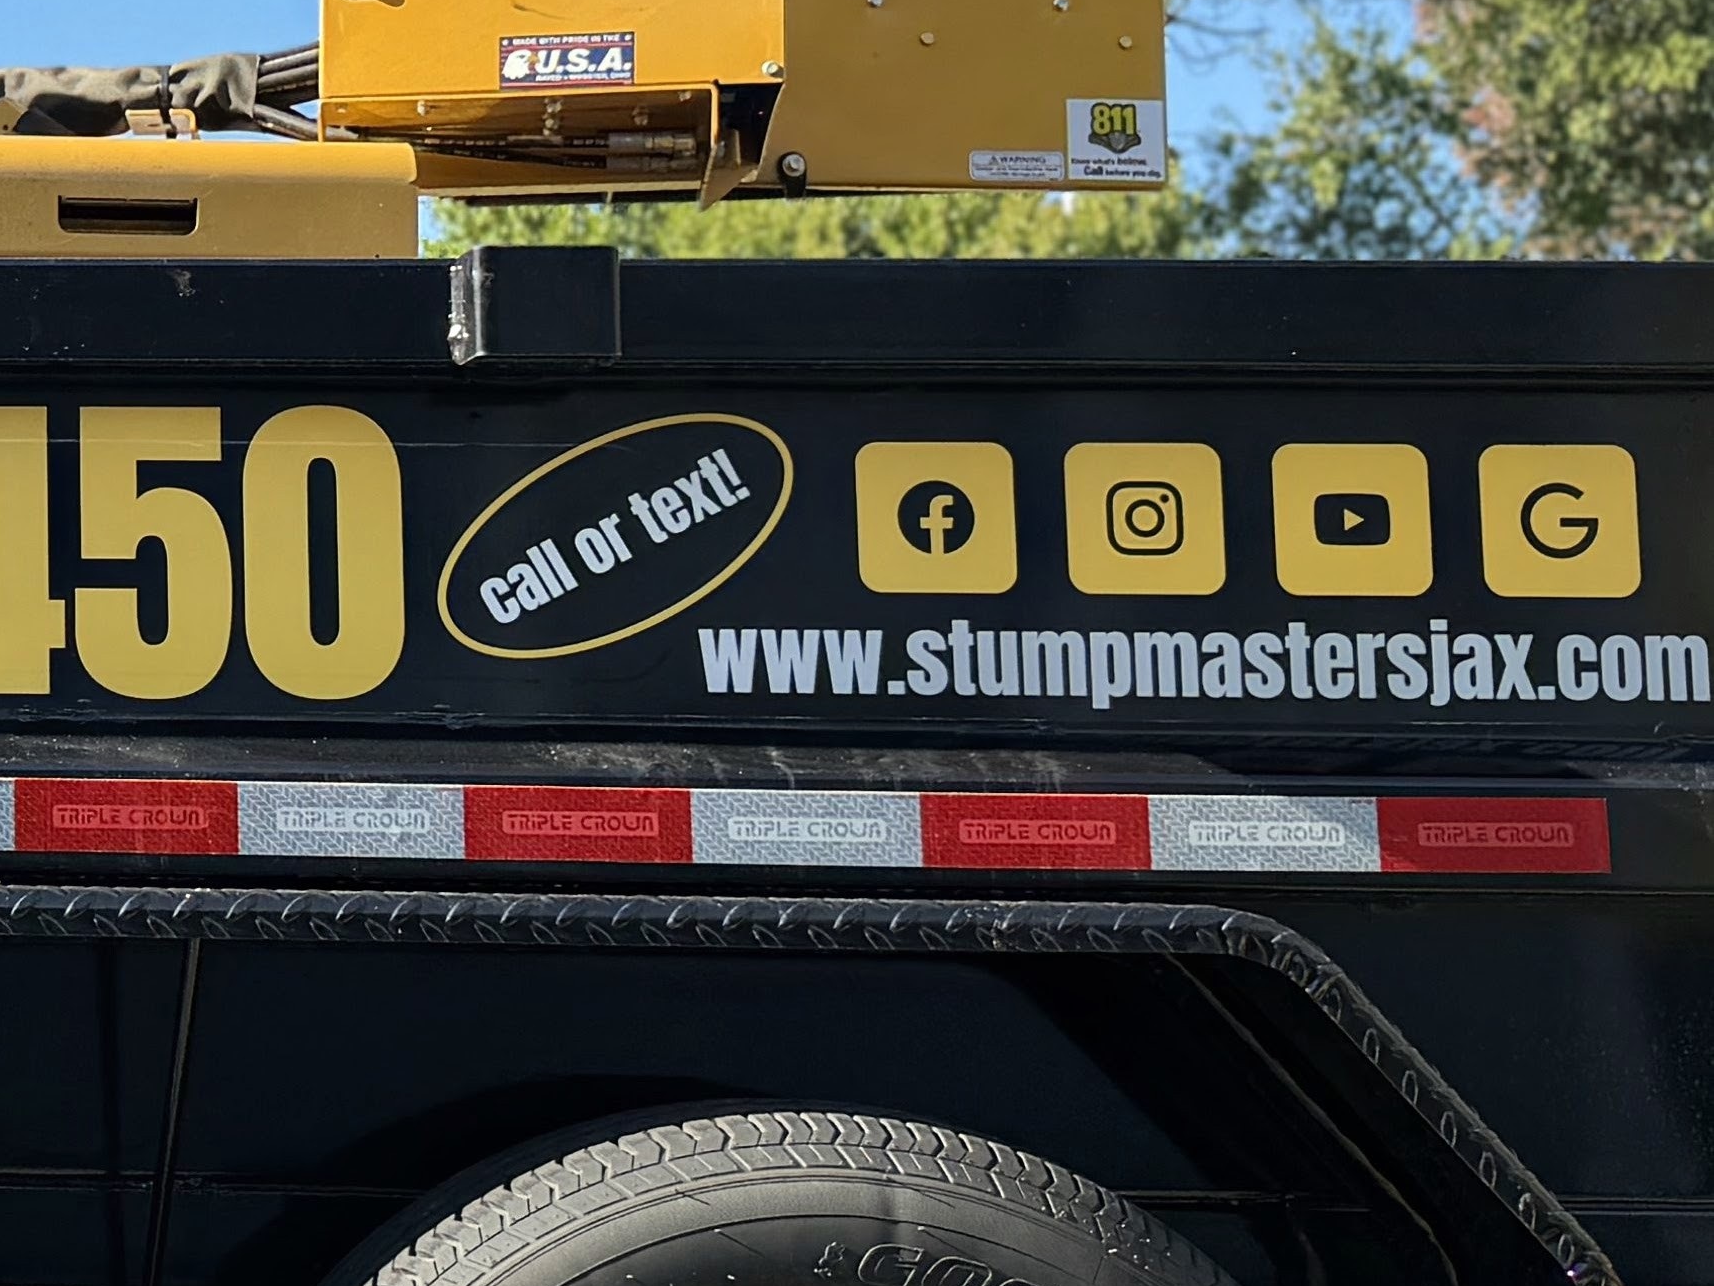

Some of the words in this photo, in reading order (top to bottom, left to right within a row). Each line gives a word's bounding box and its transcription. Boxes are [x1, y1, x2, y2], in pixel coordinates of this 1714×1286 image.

[534, 47, 632, 74] U.S.A.
[1091, 102, 1136, 136] 811
[479, 538, 579, 624] call
[574, 513, 633, 574] or
[628, 448, 751, 544] text!
[698, 619, 1711, 709] www.stumpmastersjax.com
[57, 808, 118, 825] TRIPLE
[128, 808, 201, 825] CROWN
[508, 814, 572, 832] TRIPLE
[581, 814, 654, 832] CROWN
[734, 820, 799, 838] TRIPLE
[809, 820, 881, 838] CROWN
[964, 823, 1029, 841] TRIPLE
[1038, 823, 1111, 841] CROWN
[1194, 824, 1258, 842] TRIPLE
[1267, 824, 1340, 842] CROWN
[1422, 825, 1487, 843] TRIPLE
[1495, 825, 1570, 843] CROWN
